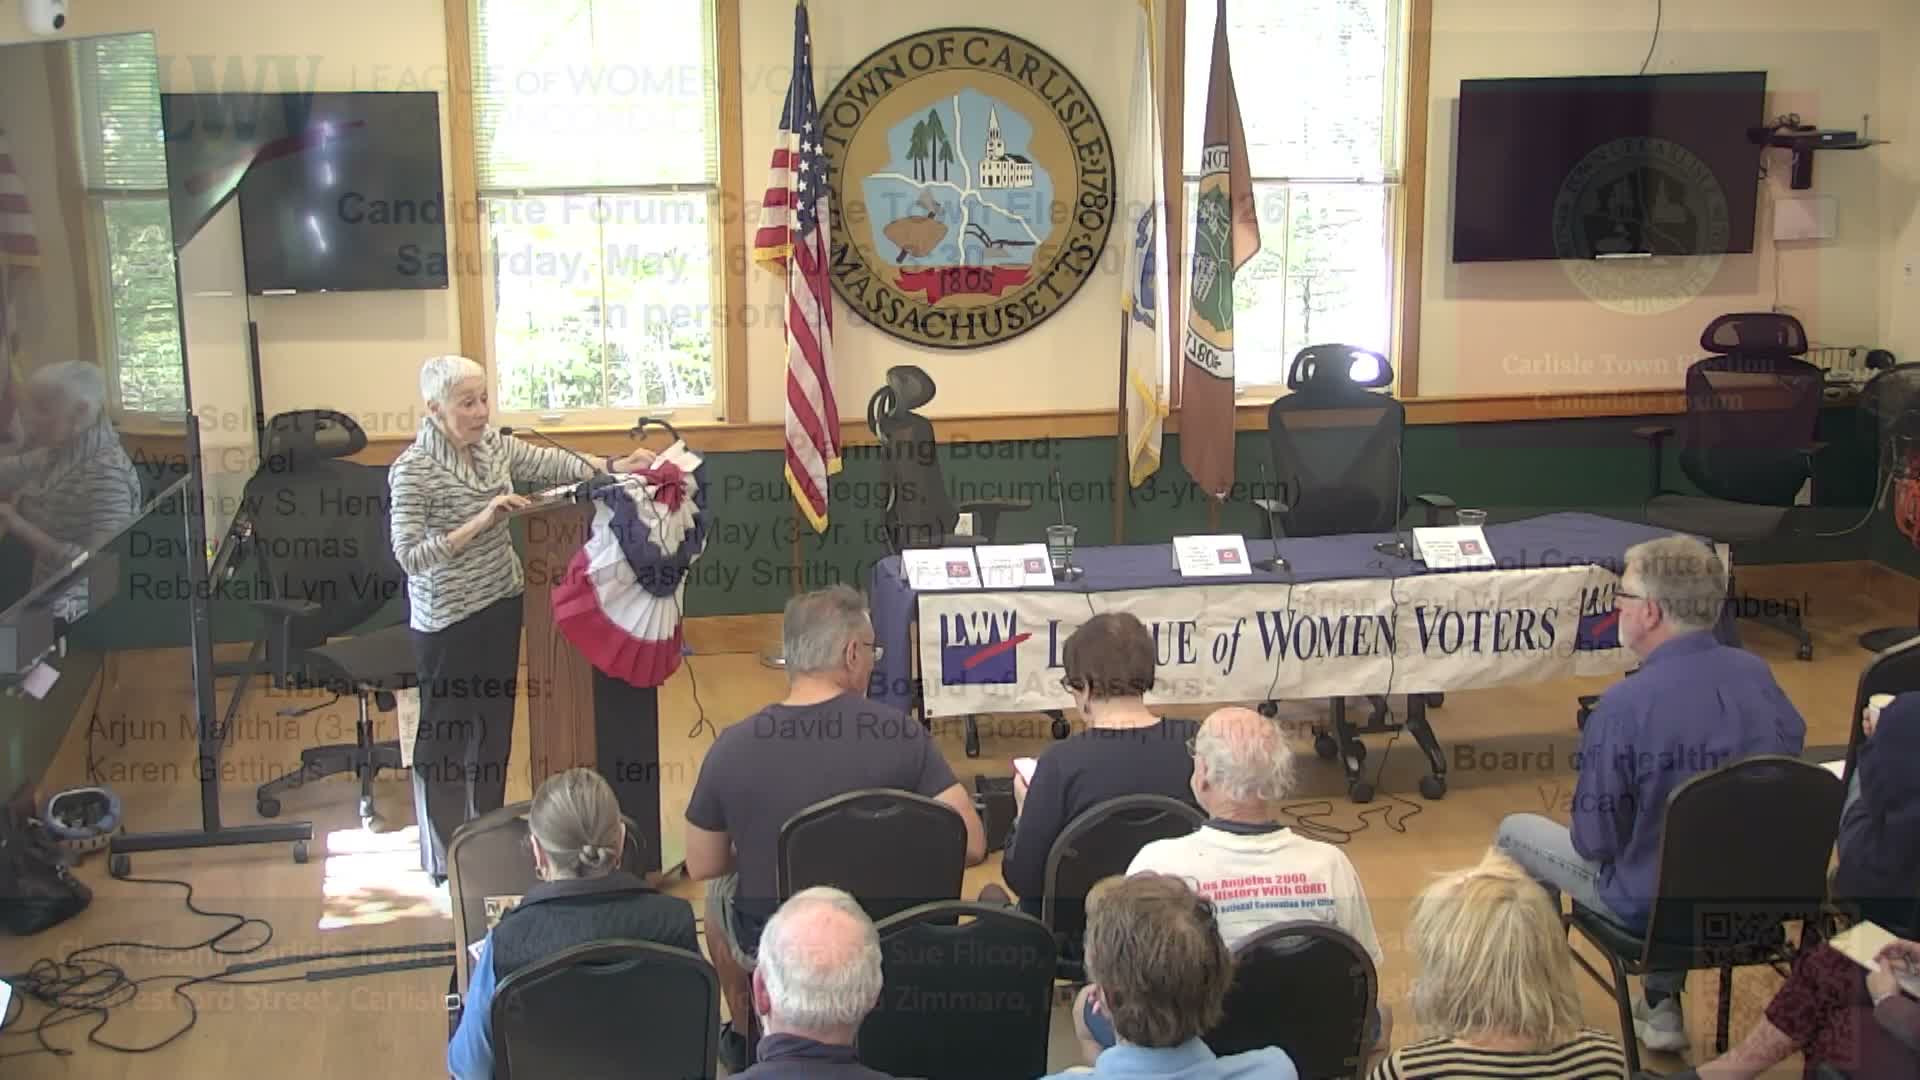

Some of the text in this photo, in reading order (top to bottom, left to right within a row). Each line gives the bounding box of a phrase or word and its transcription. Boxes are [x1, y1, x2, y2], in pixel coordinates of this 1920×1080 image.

[822, 55, 906, 148] TOWN
[907, 38, 955, 70] OF
[963, 36, 1105, 162] CARLISLE
[830, 236, 1095, 341] MASSACHUSETTS
[945, 610, 1018, 648] LWV
[1047, 619, 1198, 668] LUE
[1211, 616, 1247, 677] of
[1255, 609, 1398, 664] WOMEN
[1414, 604, 1559, 656] VOTERS
[1262, 885, 1292, 897] With
